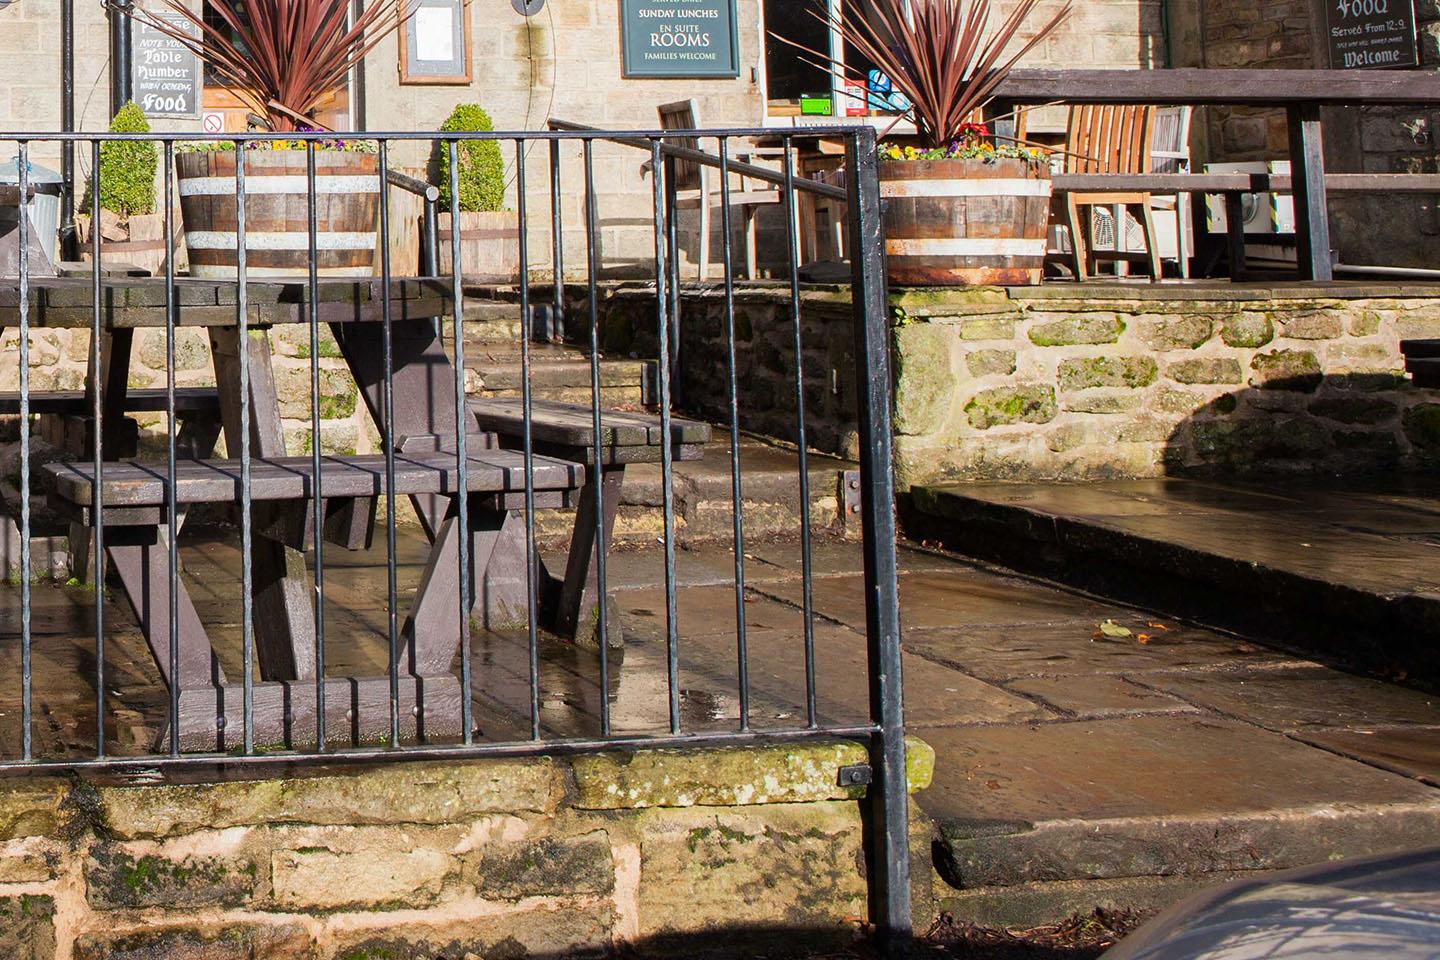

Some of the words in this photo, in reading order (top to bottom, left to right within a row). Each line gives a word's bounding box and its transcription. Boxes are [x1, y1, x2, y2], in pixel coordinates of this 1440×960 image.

[639, 10, 676, 18] SUNDAY
[677, 10, 718, 18] LUNCHES
[1331, 25, 1363, 37] Served
[1364, 23, 1386, 33] From
[140, 39, 163, 48] NOTE
[650, 33, 710, 47] ROOMS
[144, 50, 183, 64] Table
[1344, 49, 1401, 68] Welcome
[138, 66, 189, 79] Number
[141, 93, 187, 112] Food
